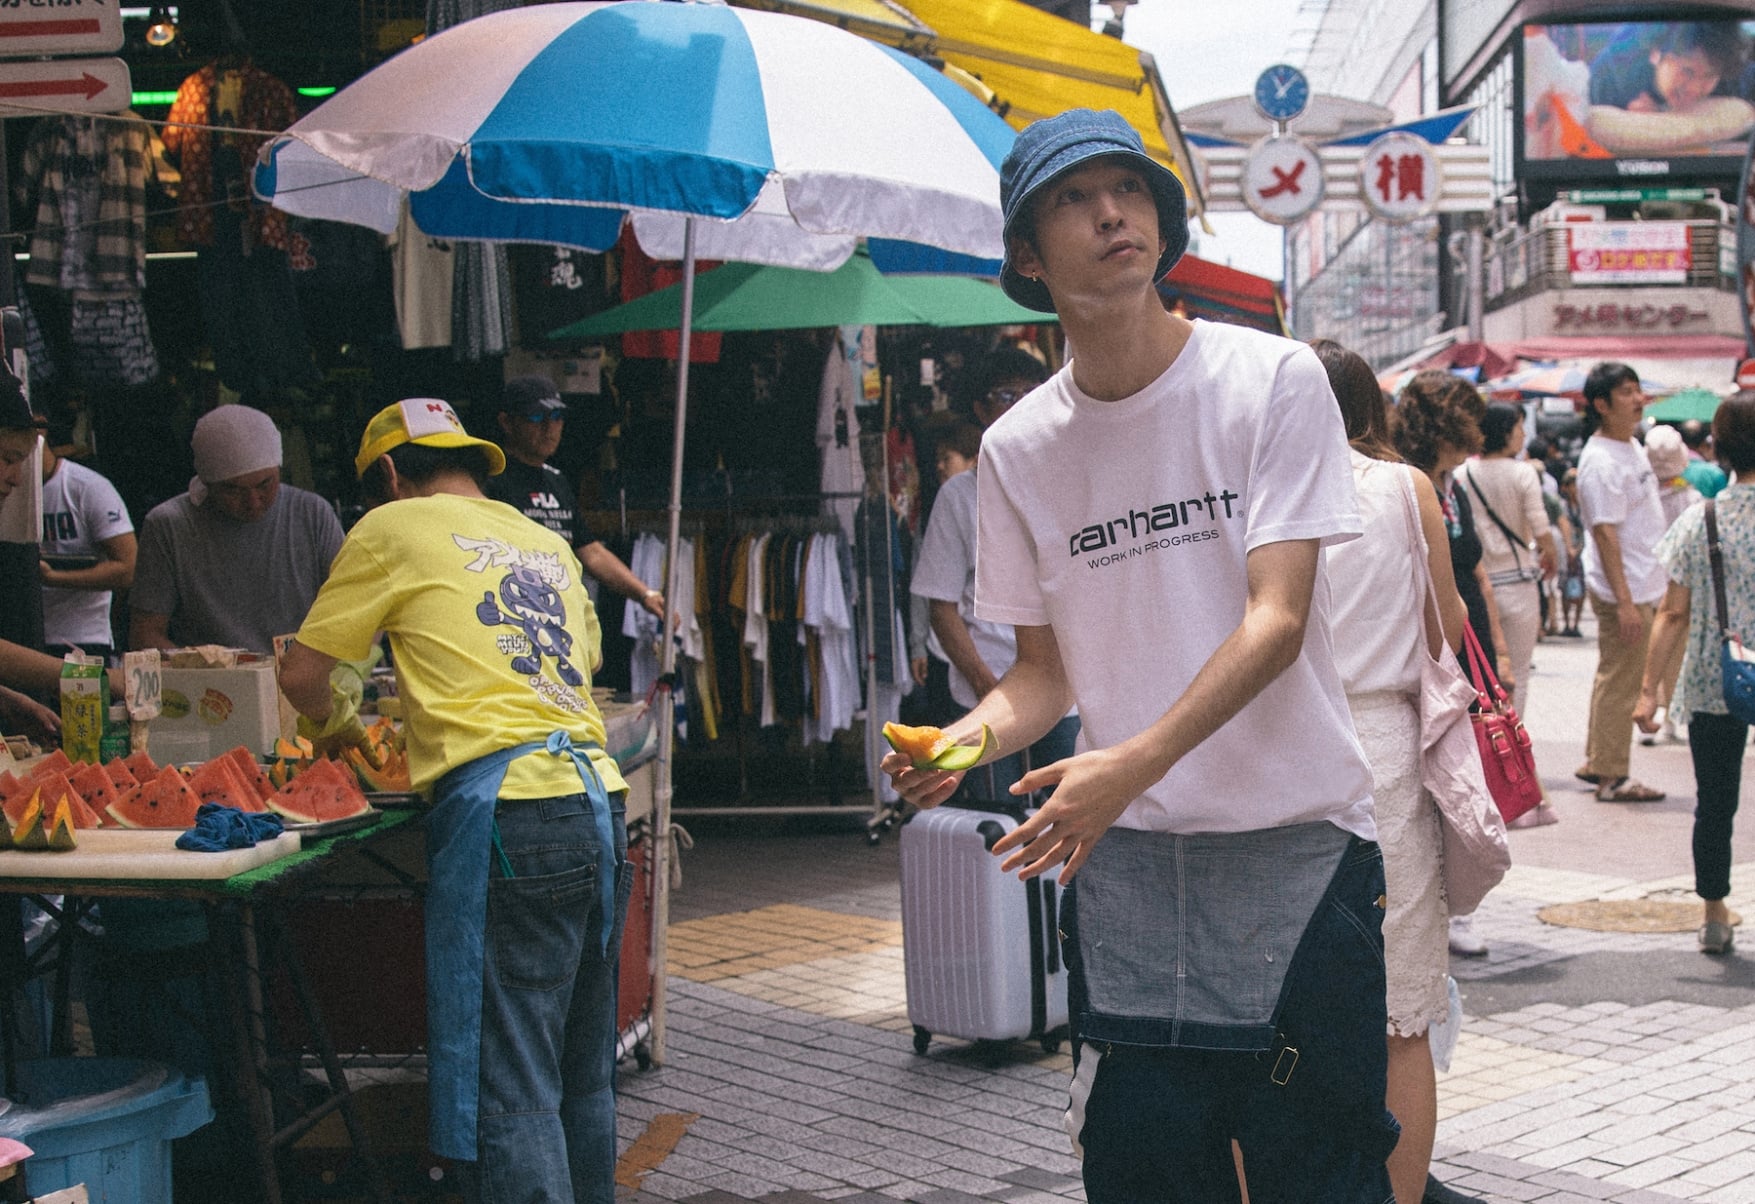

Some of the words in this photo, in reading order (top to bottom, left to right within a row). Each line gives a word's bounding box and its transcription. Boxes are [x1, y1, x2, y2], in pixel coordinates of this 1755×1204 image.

[528, 491, 560, 509] FILA
[1070, 489, 1238, 557] carhartt
[1087, 550, 1128, 569] WORK
[1129, 547, 1142, 558] IN
[1145, 529, 1220, 554] PROGRESS
[133, 667, 160, 708] 200
